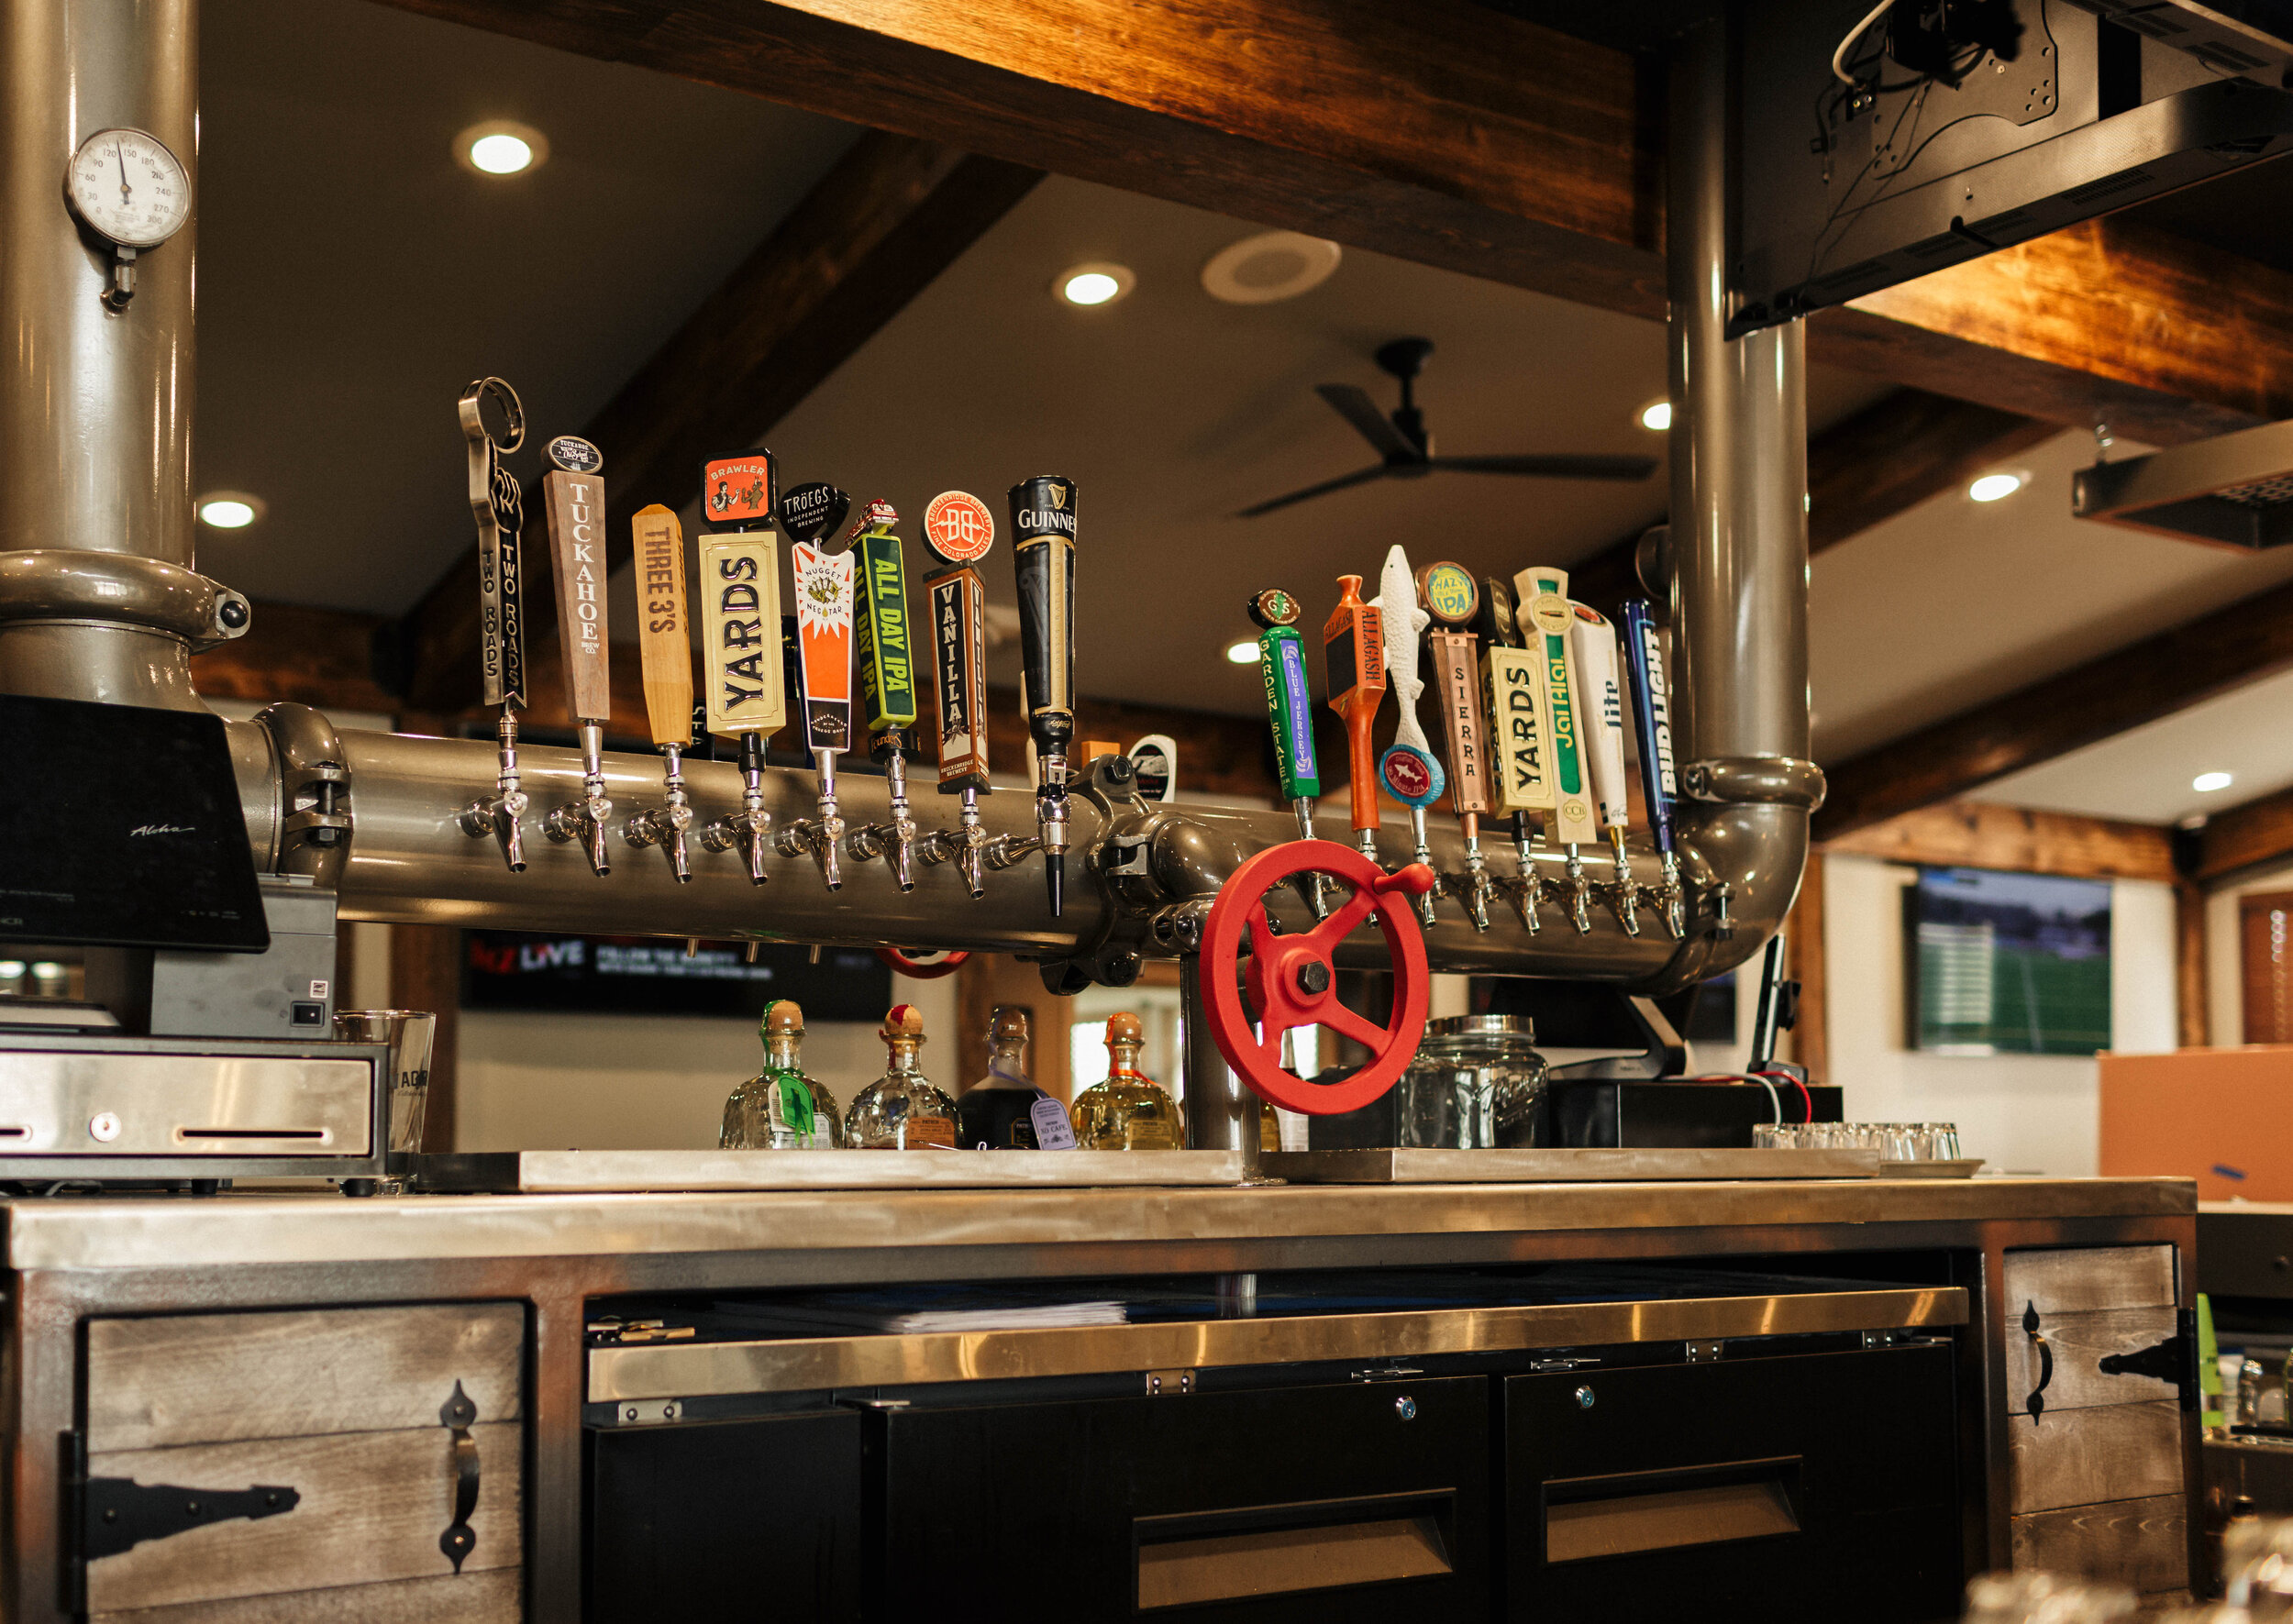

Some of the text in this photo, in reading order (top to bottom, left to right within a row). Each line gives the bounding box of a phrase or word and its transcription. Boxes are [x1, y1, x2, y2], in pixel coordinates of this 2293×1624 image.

[104, 149, 116, 158] 120
[124, 149, 137, 158] 150
[141, 157, 154, 165] 180
[156, 187, 171, 196] 240
[147, 215, 162, 224] 300
[154, 204, 169, 213] 270
[710, 464, 765, 481] BRAWLER
[784, 486, 829, 515] TRÖEGS
[788, 506, 828, 524] INDEPENDENT
[929, 494, 991, 528] BRECKENRIDGE BREWERY
[797, 516, 824, 528] BREWING
[932, 531, 991, 558] FINE COLORADO ALES
[570, 483, 598, 640] TUCKAHOE
[805, 567, 842, 580] NUGGET
[645, 527, 676, 634] THREE 3'S
[1435, 578, 1463, 590] HAZY
[483, 551, 497, 677] TWO ROADS
[503, 544, 519, 688] TWO ROADS
[1268, 600, 1290, 614] G S
[1436, 593, 1466, 613] IPA
[719, 557, 764, 713] YARDS
[857, 612, 871, 656] DAY
[875, 558, 909, 691] ALL DAY IPA
[941, 584, 962, 723] VANILLA
[974, 585, 984, 725] VANILLA
[1362, 611, 1380, 680] ALLAGASH
[862, 660, 877, 702] IPA
[1260, 639, 1286, 779] GARDEN STATE
[1289, 659, 1306, 759] BLUE JERSEY
[1604, 680, 1622, 729] lite
[1455, 668, 1475, 777] SIERRA
[1504, 668, 1542, 790] YARDS
[1656, 724, 1678, 795] BUD
[1565, 805, 1585, 815] CCB
[130, 823, 195, 836] Aloha
[520, 941, 584, 972] LIVE
